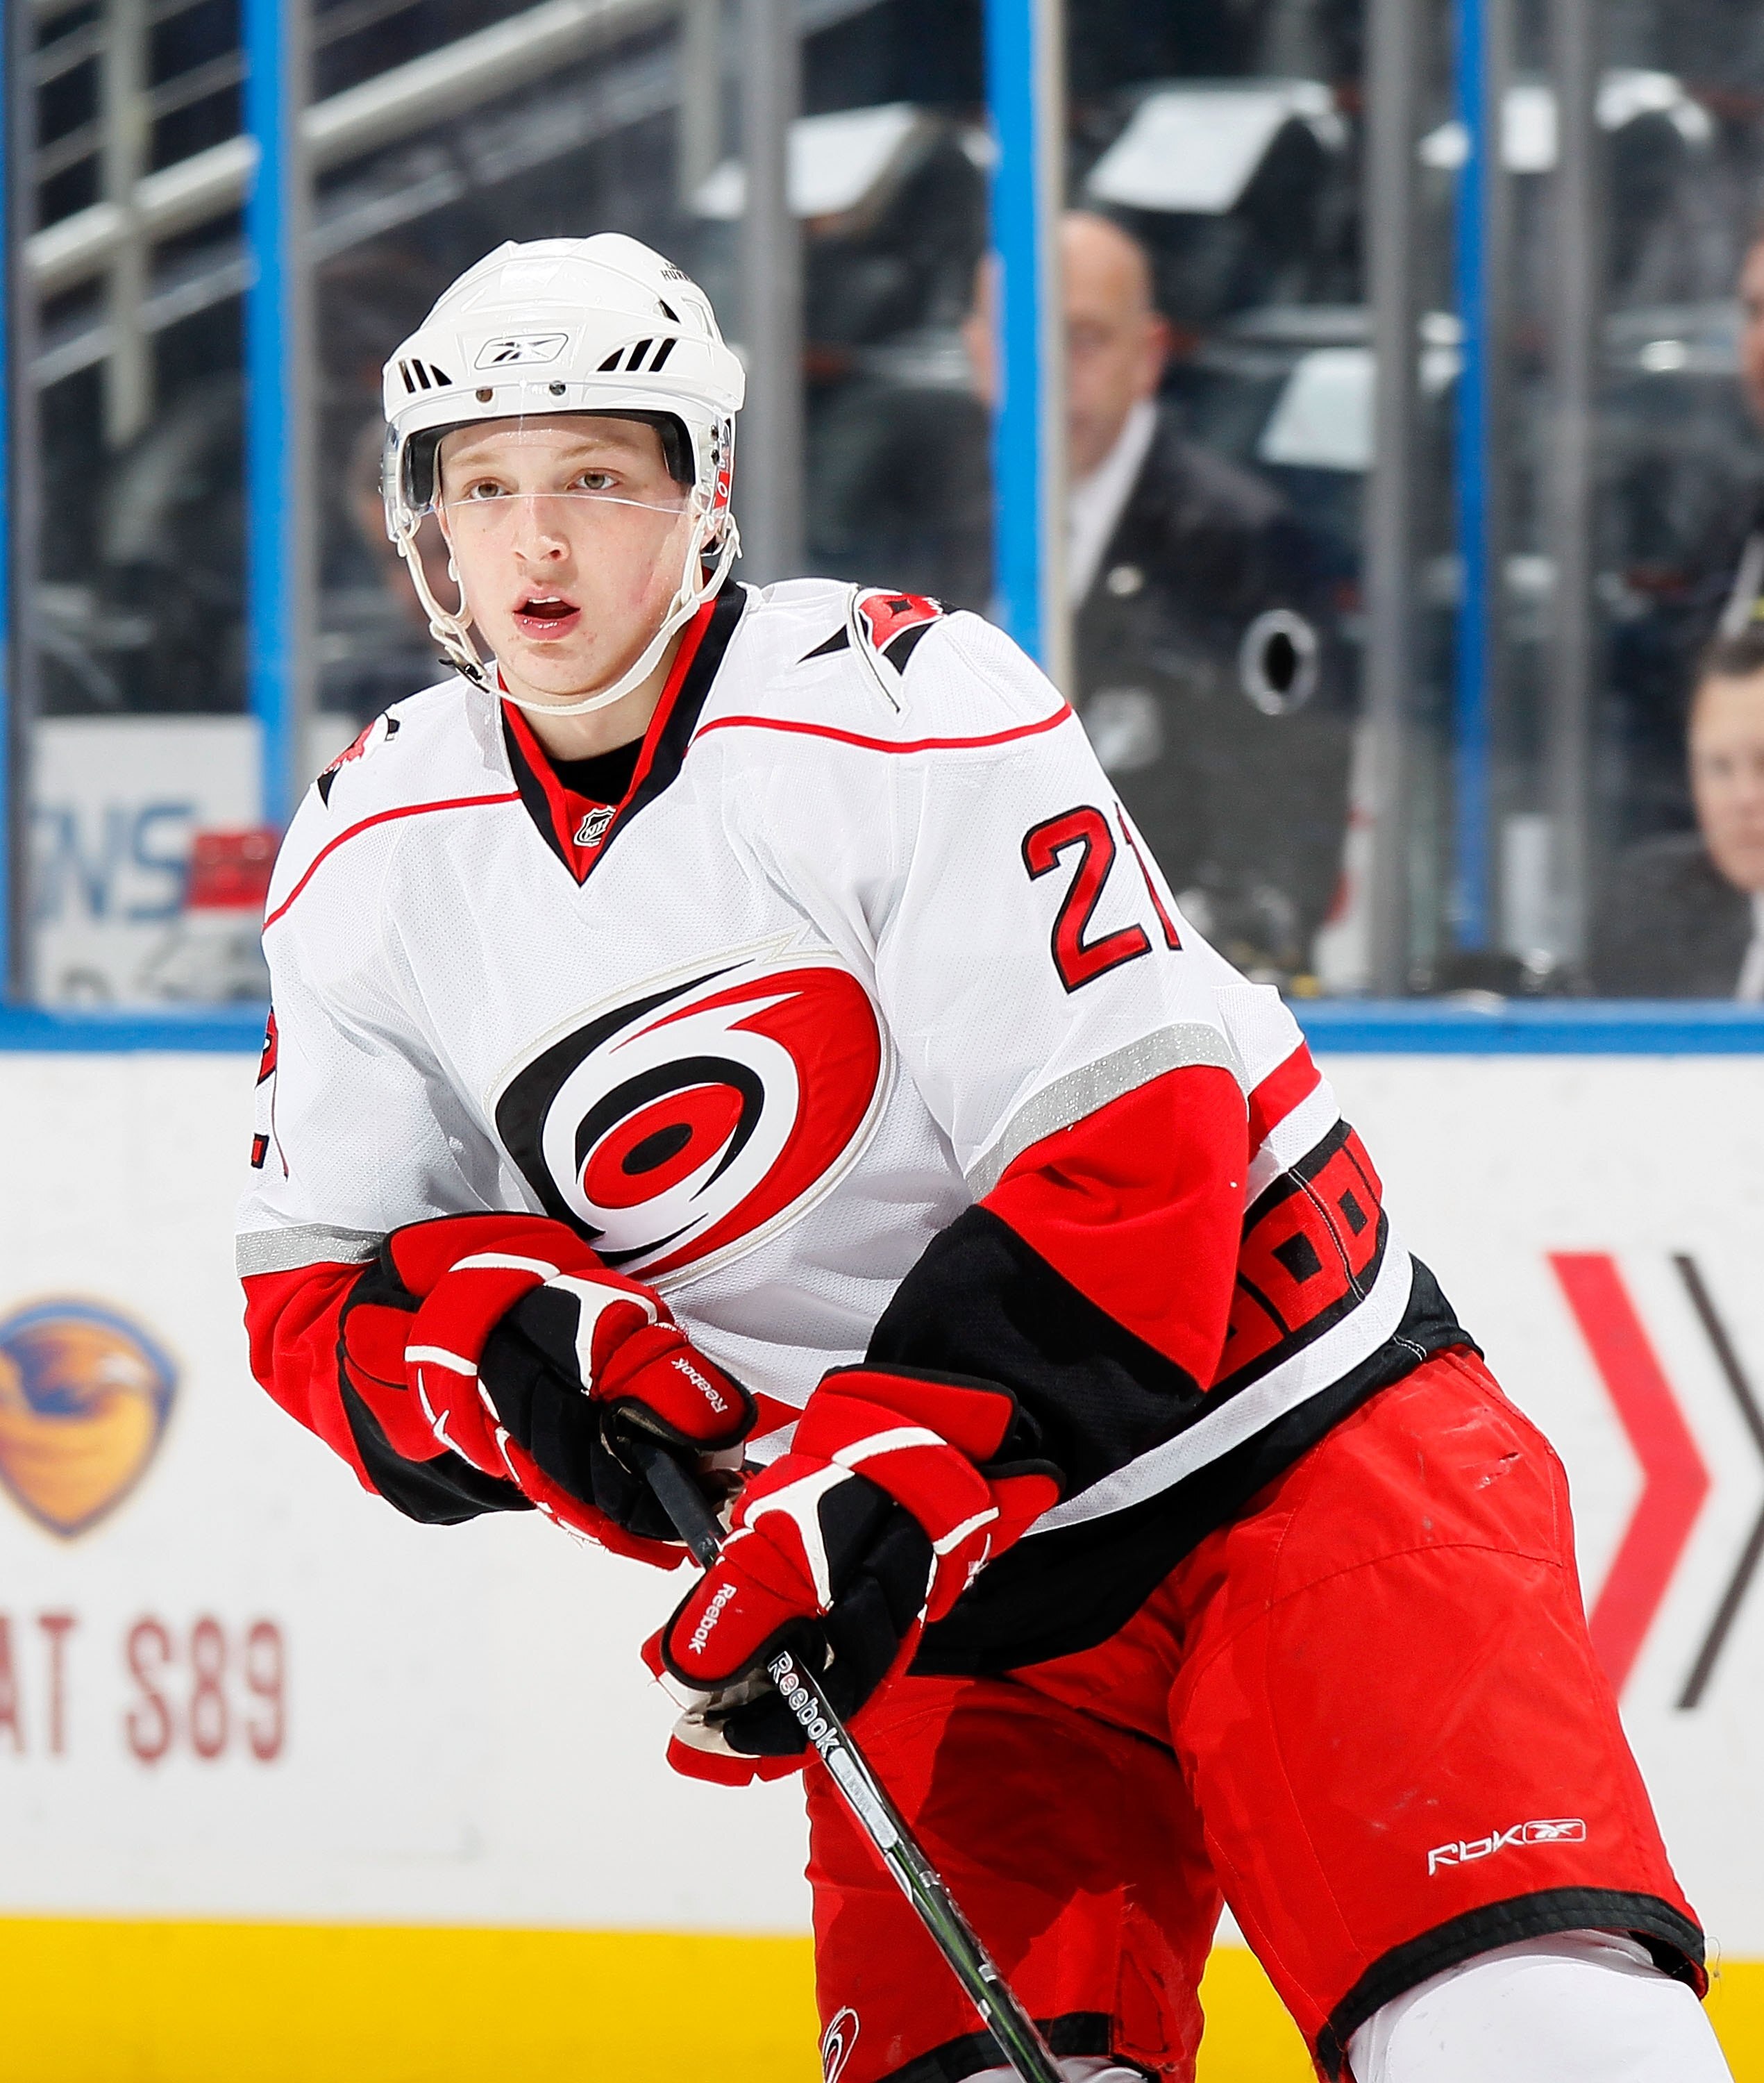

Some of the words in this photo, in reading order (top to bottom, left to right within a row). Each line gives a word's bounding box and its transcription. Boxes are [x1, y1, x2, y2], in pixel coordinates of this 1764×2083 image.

[671, 1357, 728, 1413] Reebok
[688, 1583, 737, 1655] Reebok
[767, 1650, 840, 1759] Reebok
